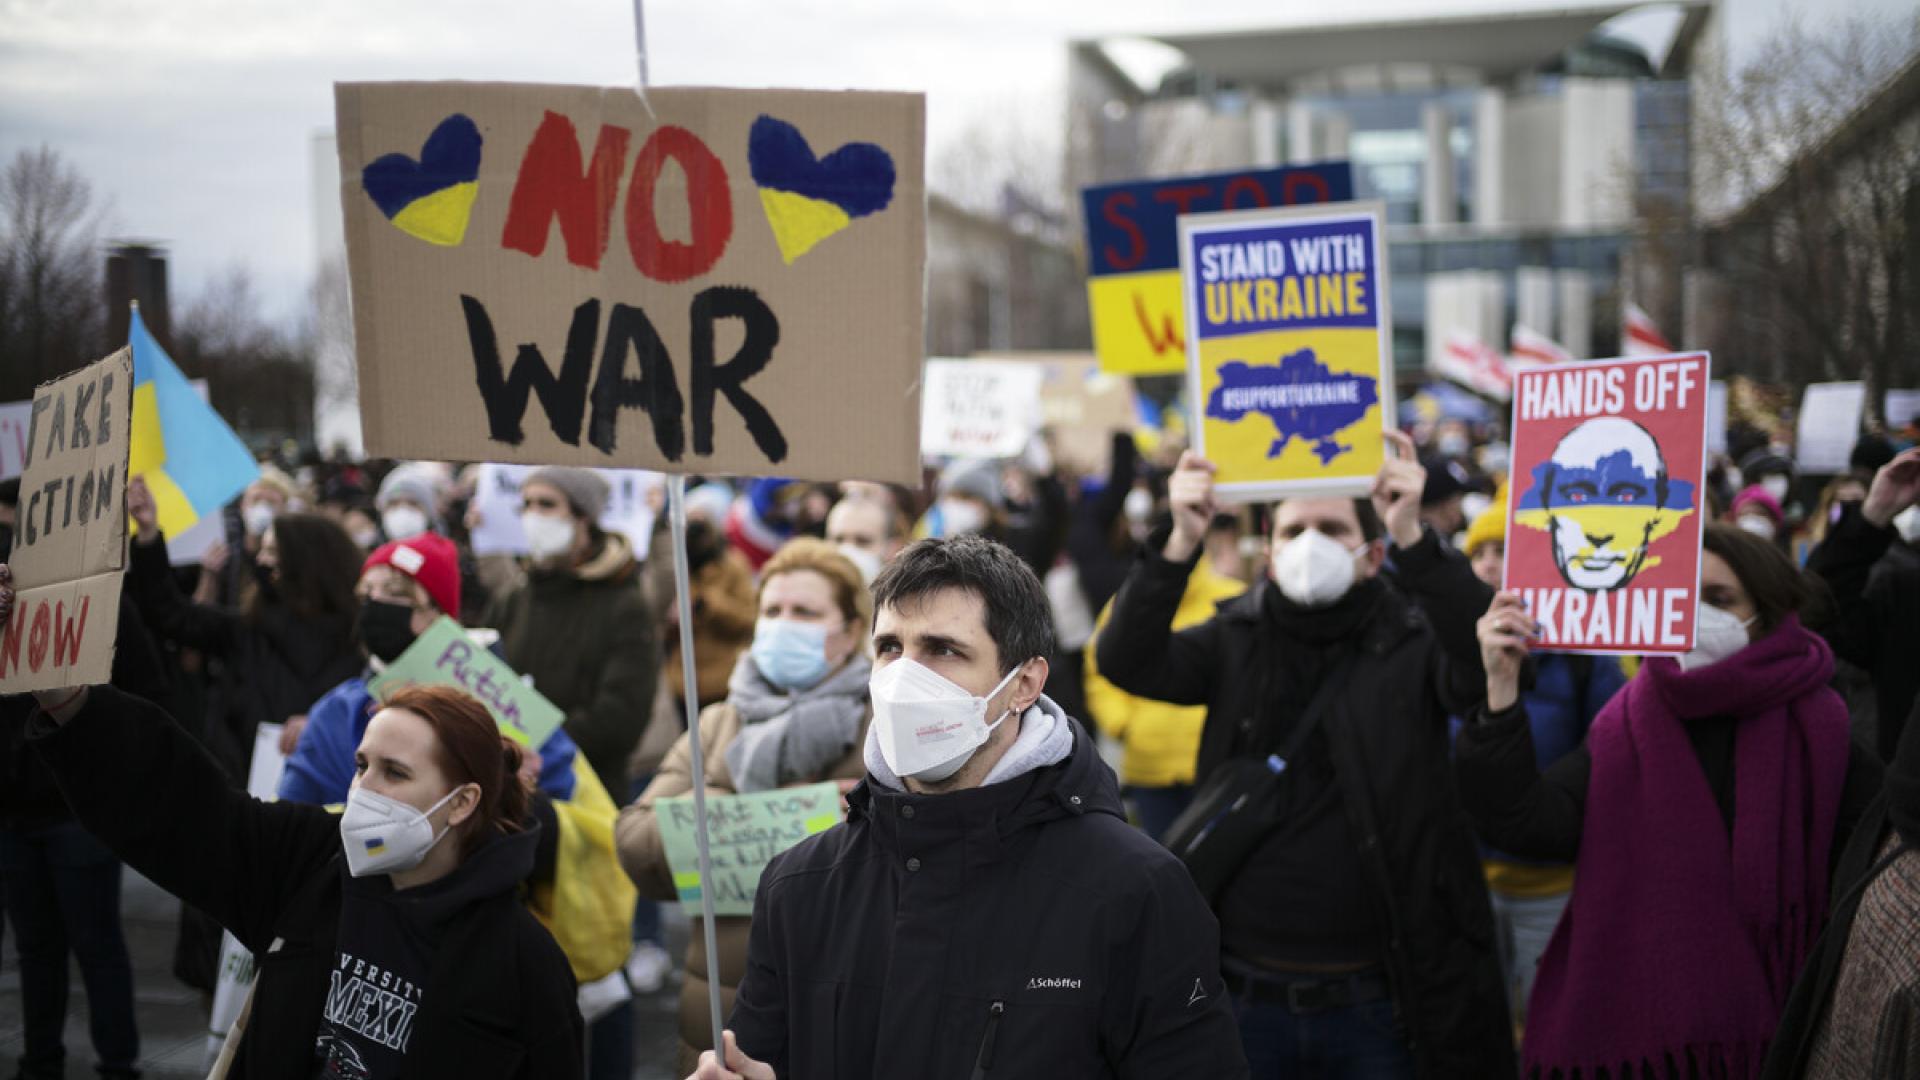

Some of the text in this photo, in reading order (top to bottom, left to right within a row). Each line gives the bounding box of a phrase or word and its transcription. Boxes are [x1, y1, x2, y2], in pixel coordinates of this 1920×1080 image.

[502, 109, 733, 283] NO
[1201, 233, 1365, 281] STAND WITH
[1204, 272, 1367, 324] UKRAINE
[460, 285, 788, 463] WAR
[1222, 380, 1360, 411] #SUPPORTUKRAINE
[1521, 361, 1699, 420] HANDS OFF
[24, 372, 113, 470] TAKE
[0, 595, 91, 681] NOW
[324, 969, 418, 1055] MEXI
[1037, 977, 1081, 988] Schöffel
